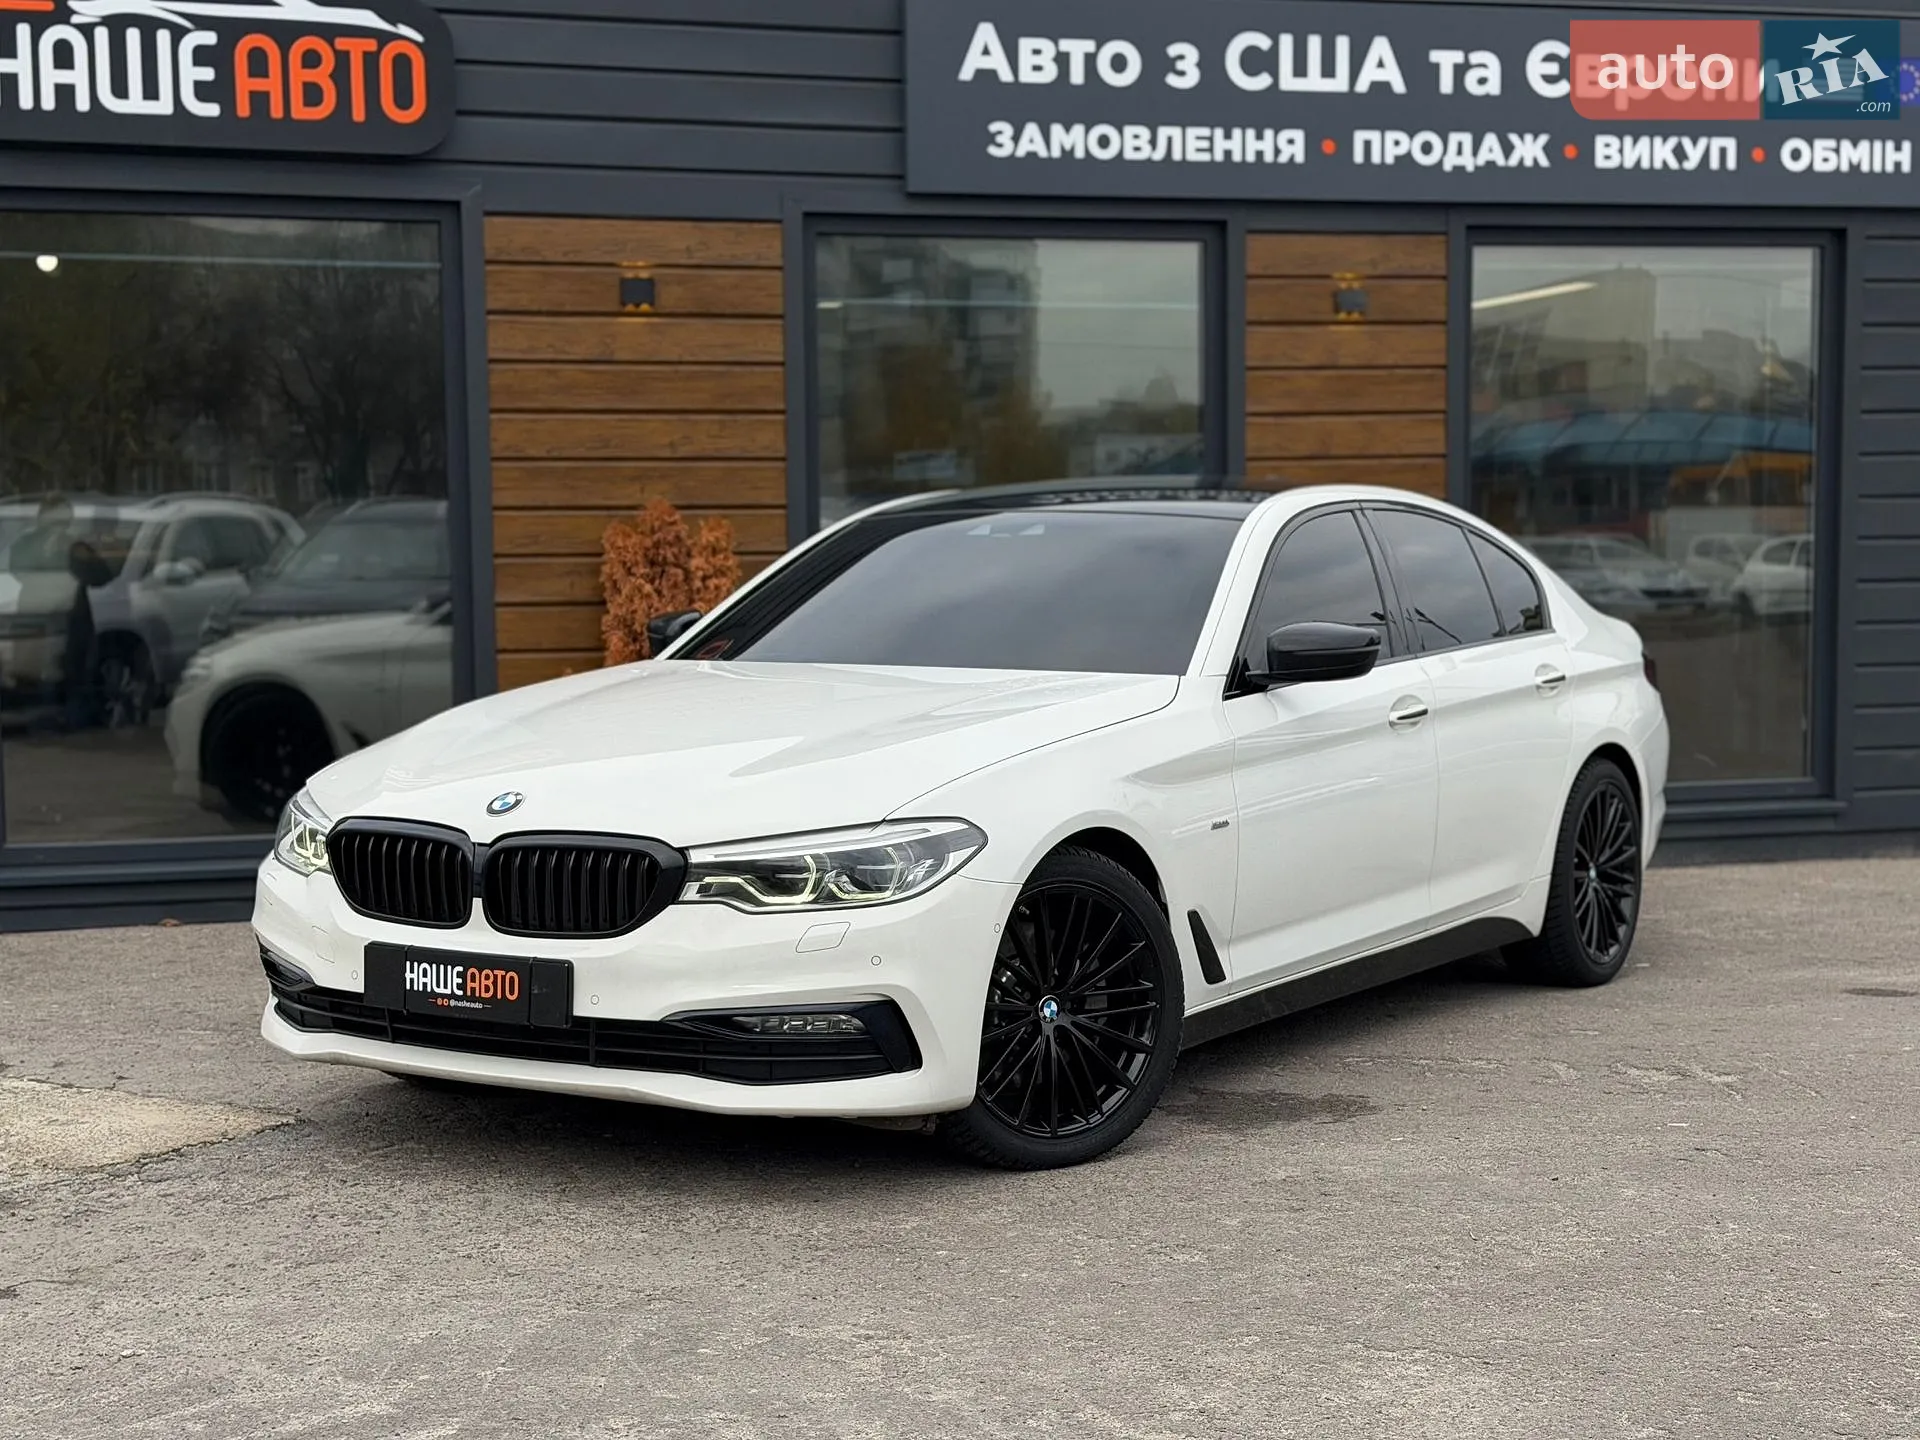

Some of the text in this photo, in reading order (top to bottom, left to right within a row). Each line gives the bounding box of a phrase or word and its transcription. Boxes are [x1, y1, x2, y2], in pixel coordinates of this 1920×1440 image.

[0, 22, 427, 124] НАШЕ АВТО
[957, 21, 1142, 88] Авто
[1164, 41, 1201, 90] з
[1224, 30, 1407, 95] США
[1428, 49, 1502, 96] та
[986, 120, 1912, 173] ЗАМОВЛЕННЯ ПРОДАЖ ВИКУП ОБМІН
[405, 960, 519, 1001] НАШЕ АВТО
